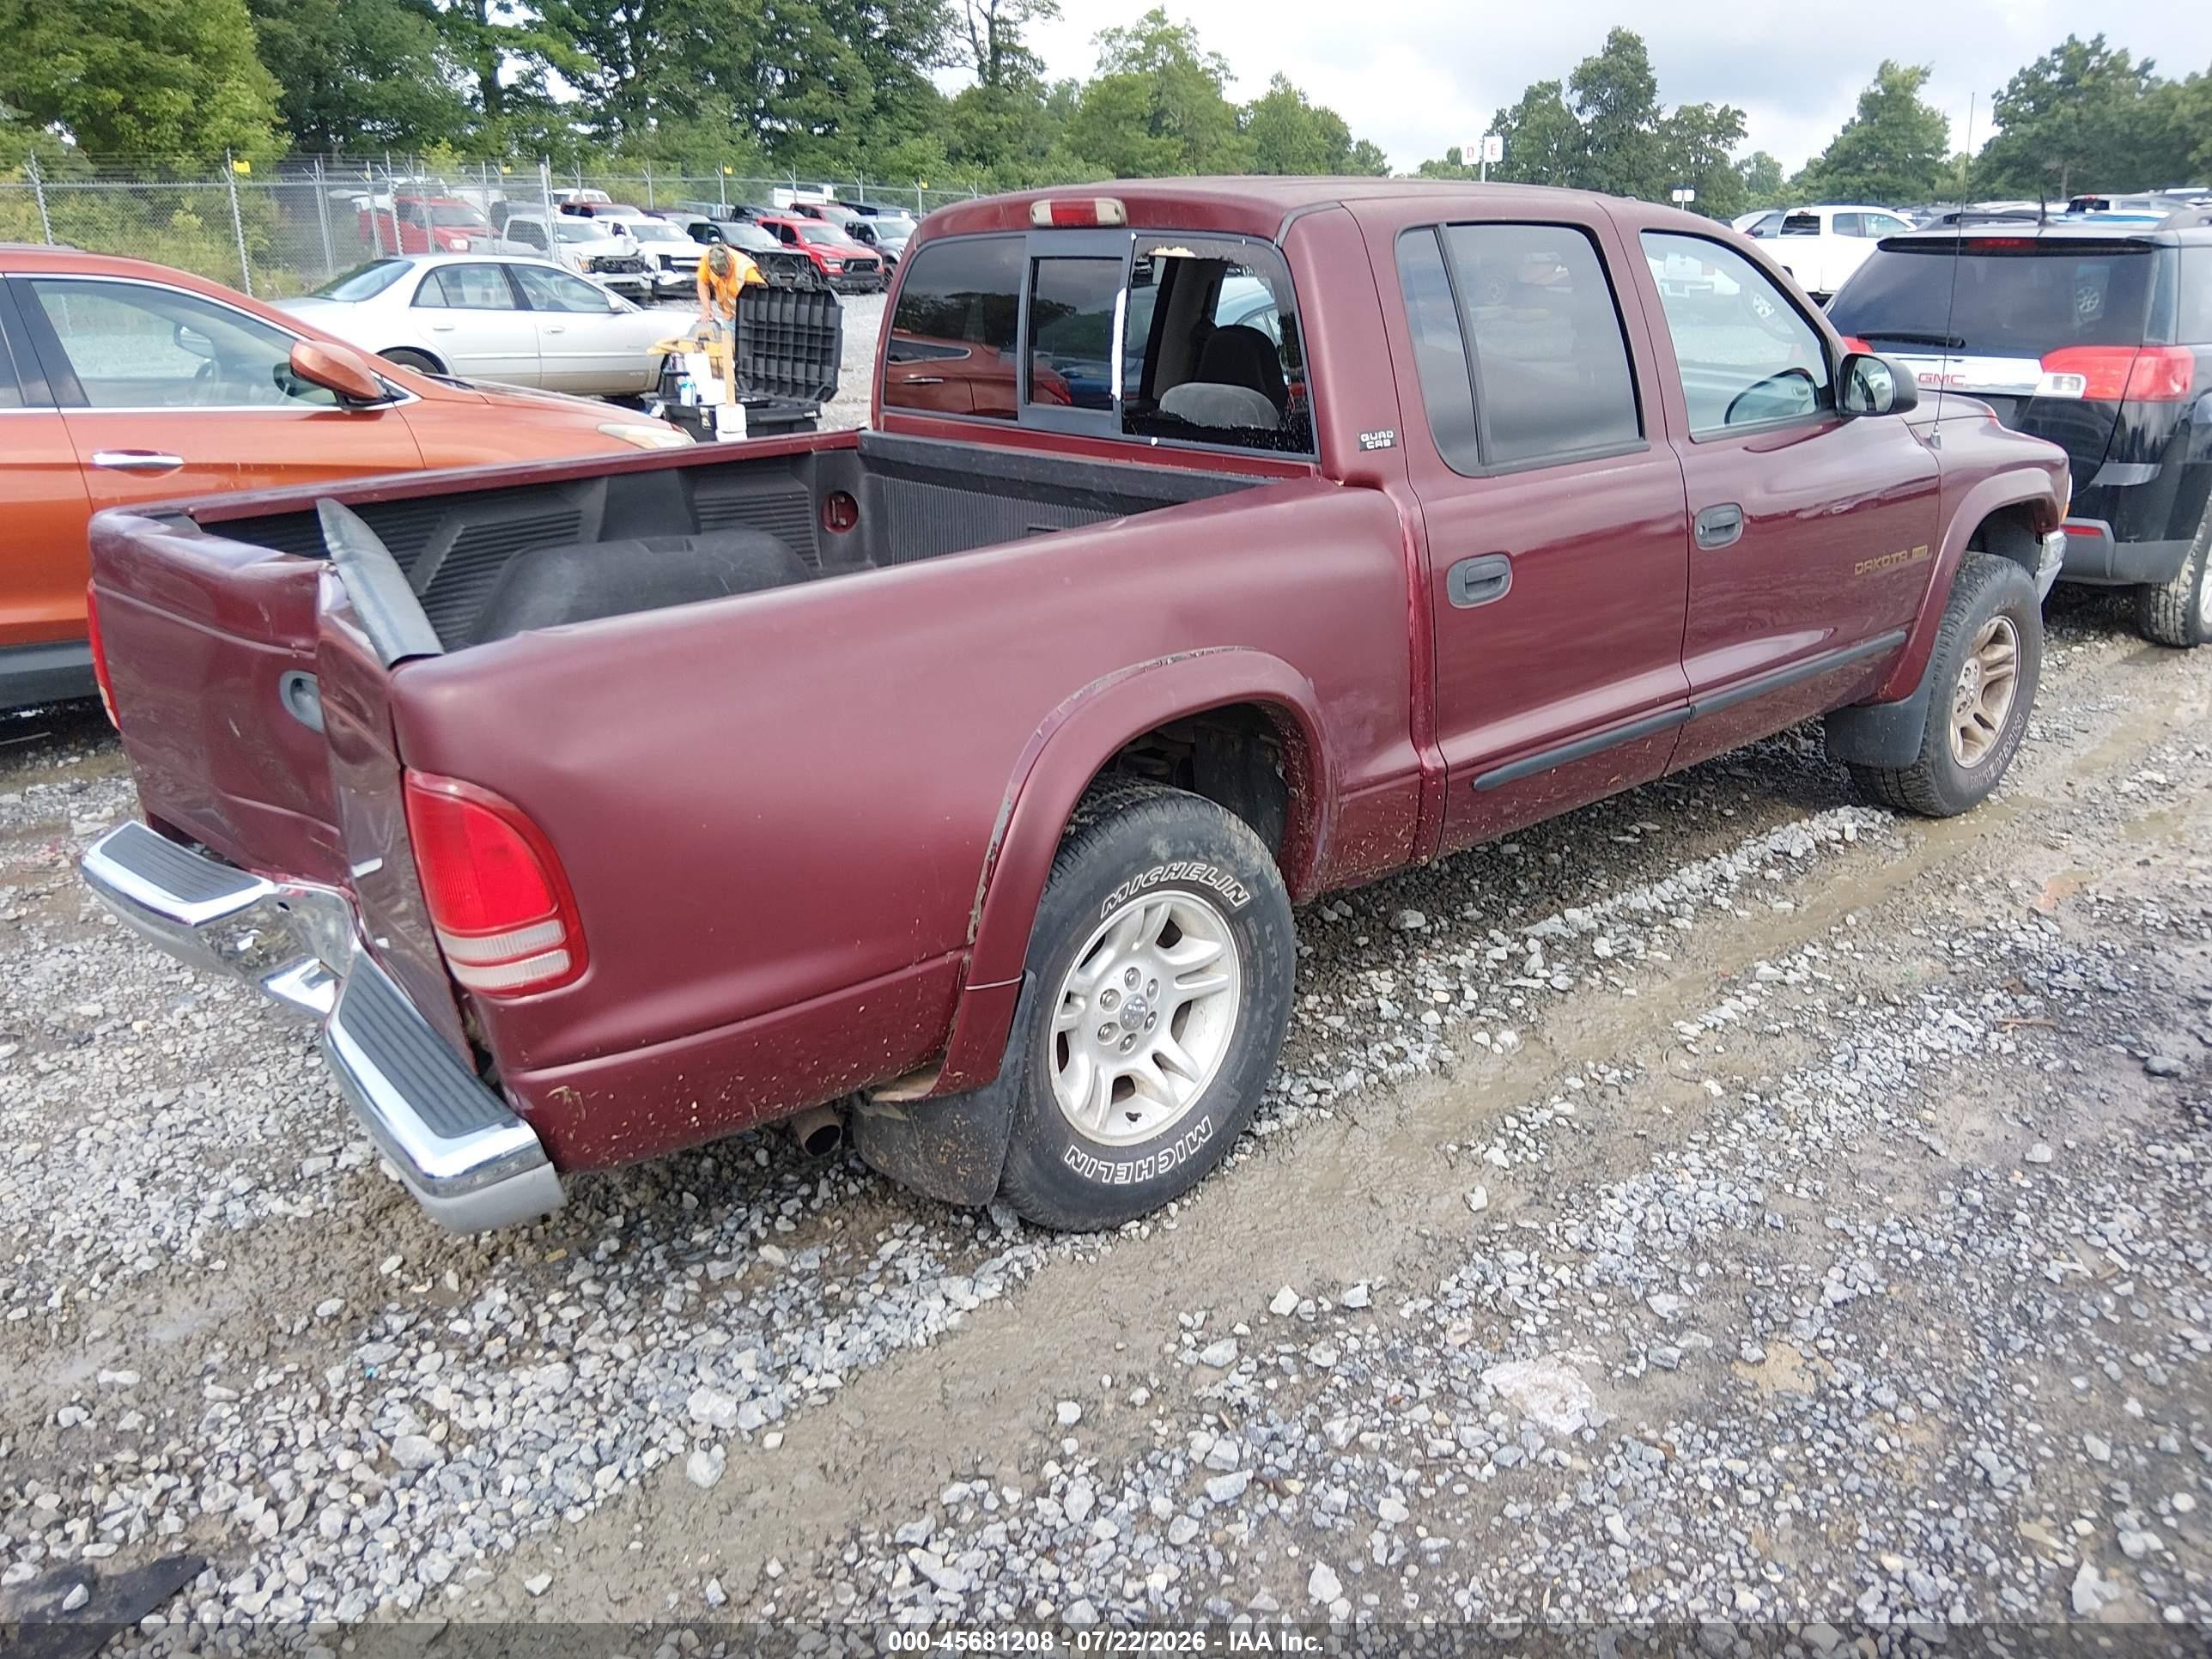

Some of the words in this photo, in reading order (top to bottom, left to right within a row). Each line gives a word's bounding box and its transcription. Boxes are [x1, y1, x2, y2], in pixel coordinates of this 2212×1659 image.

[1467, 146, 1474, 159] D
[1917, 373, 1966, 386] GMC
[1360, 430, 1394, 442] QUAD
[1366, 439, 1391, 449] CAB
[1854, 550, 1908, 576] DAKOTA
[1100, 861, 1251, 920] MICHELIN
[1064, 1115, 1213, 1184] MICHELIN
